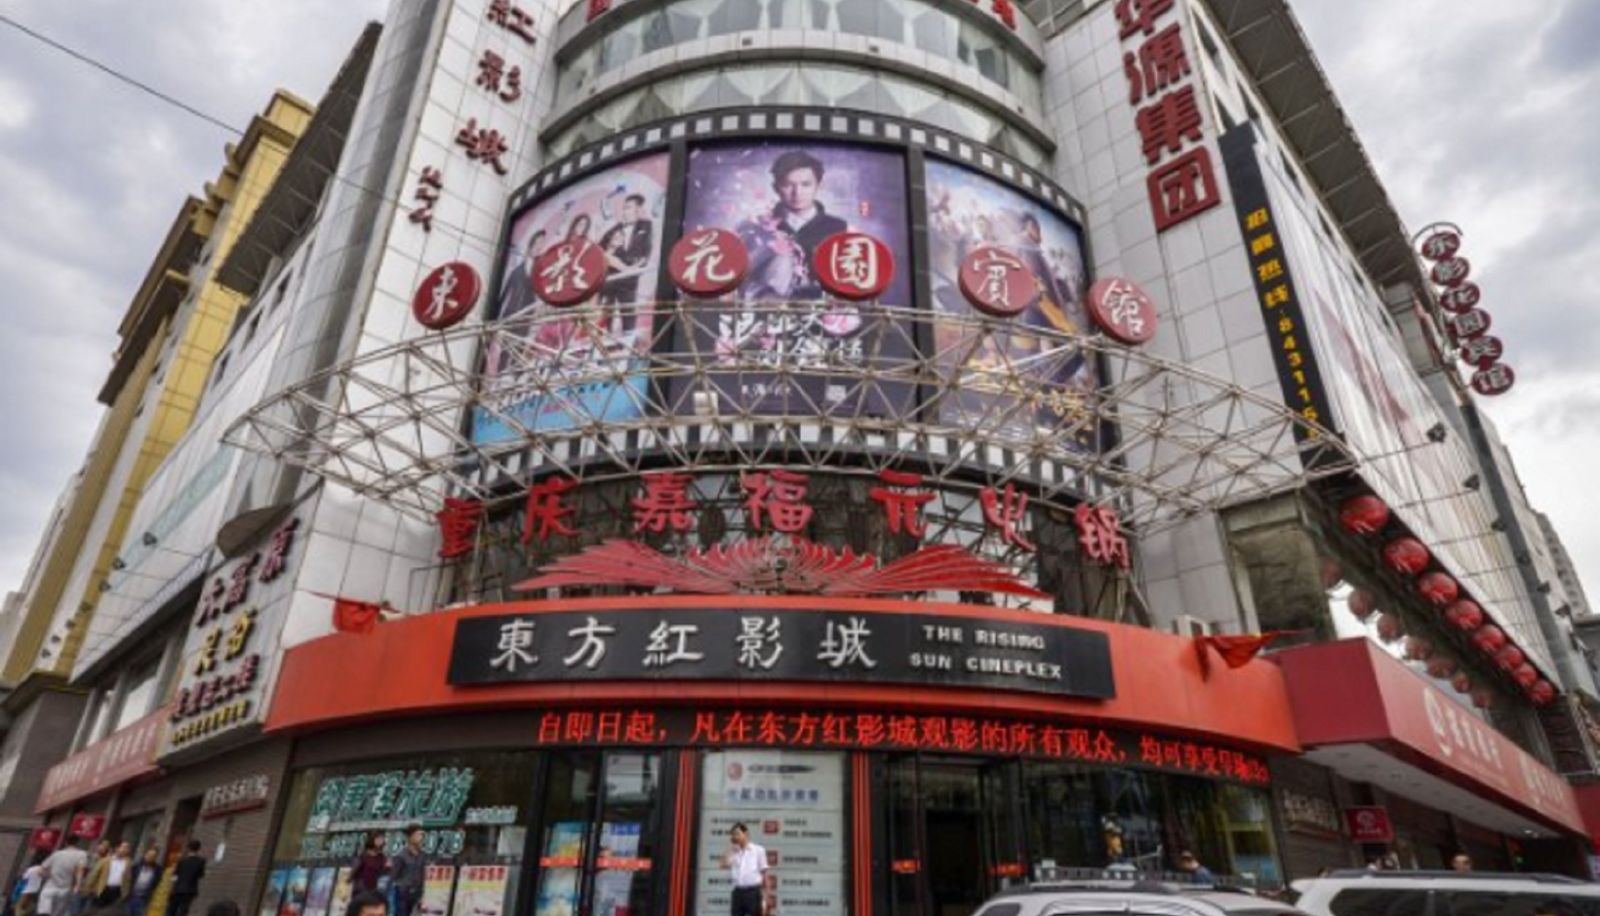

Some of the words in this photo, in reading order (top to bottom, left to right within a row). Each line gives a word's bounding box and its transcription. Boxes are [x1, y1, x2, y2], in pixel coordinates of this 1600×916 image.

[1113, 0, 1221, 234] 华源集团
[489, 615, 877, 671] 東方紅影城
[921, 624, 964, 643] THE
[974, 629, 1046, 649] RISING
[909, 652, 953, 670] SUN
[965, 656, 1063, 680] CINEPLEX
